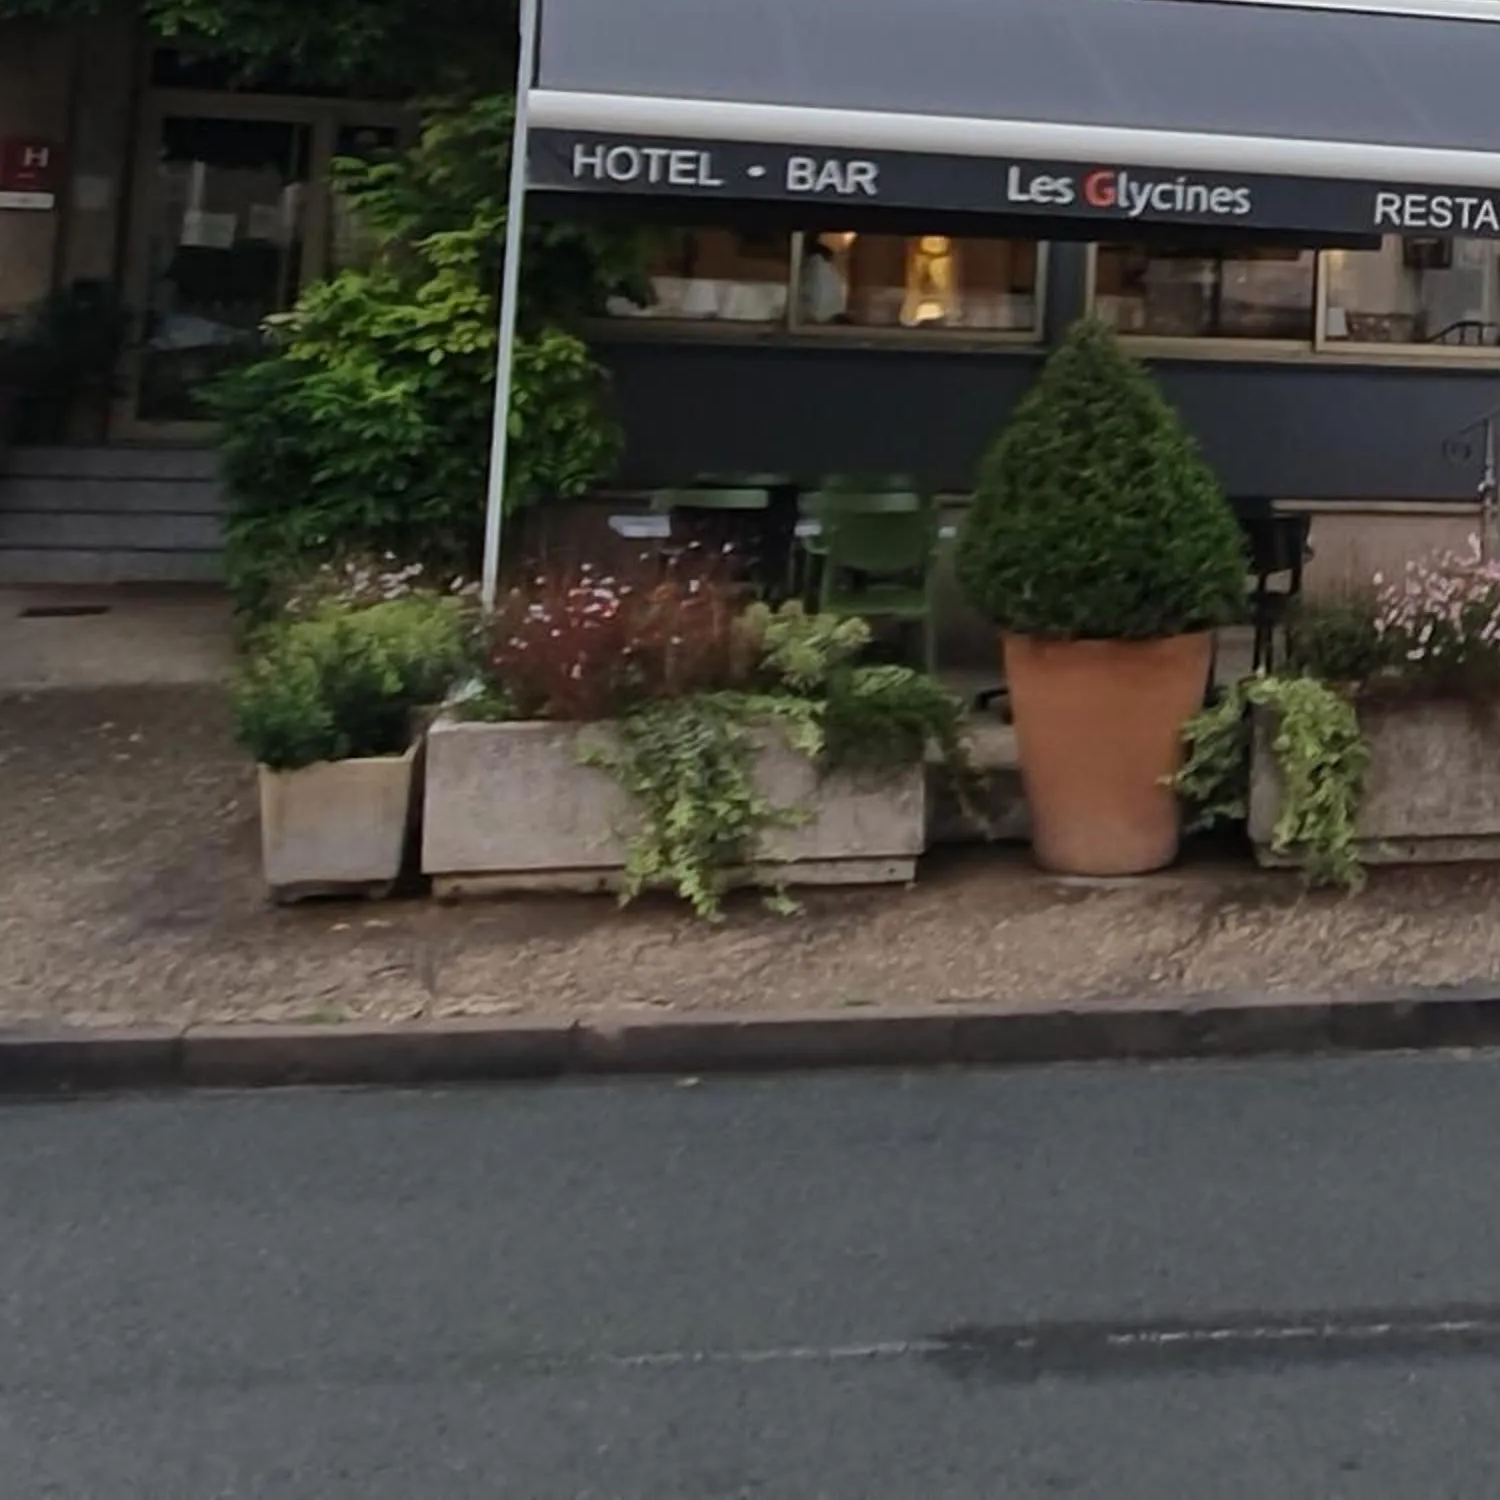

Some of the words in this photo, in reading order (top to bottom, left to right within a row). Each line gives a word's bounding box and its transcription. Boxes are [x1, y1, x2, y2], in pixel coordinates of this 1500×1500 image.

[23, 146, 49, 169] H
[572, 143, 725, 187] HOTEL
[786, 155, 879, 195] BAR
[1007, 164, 1075, 204] Les
[1083, 170, 1252, 217] Glycines
